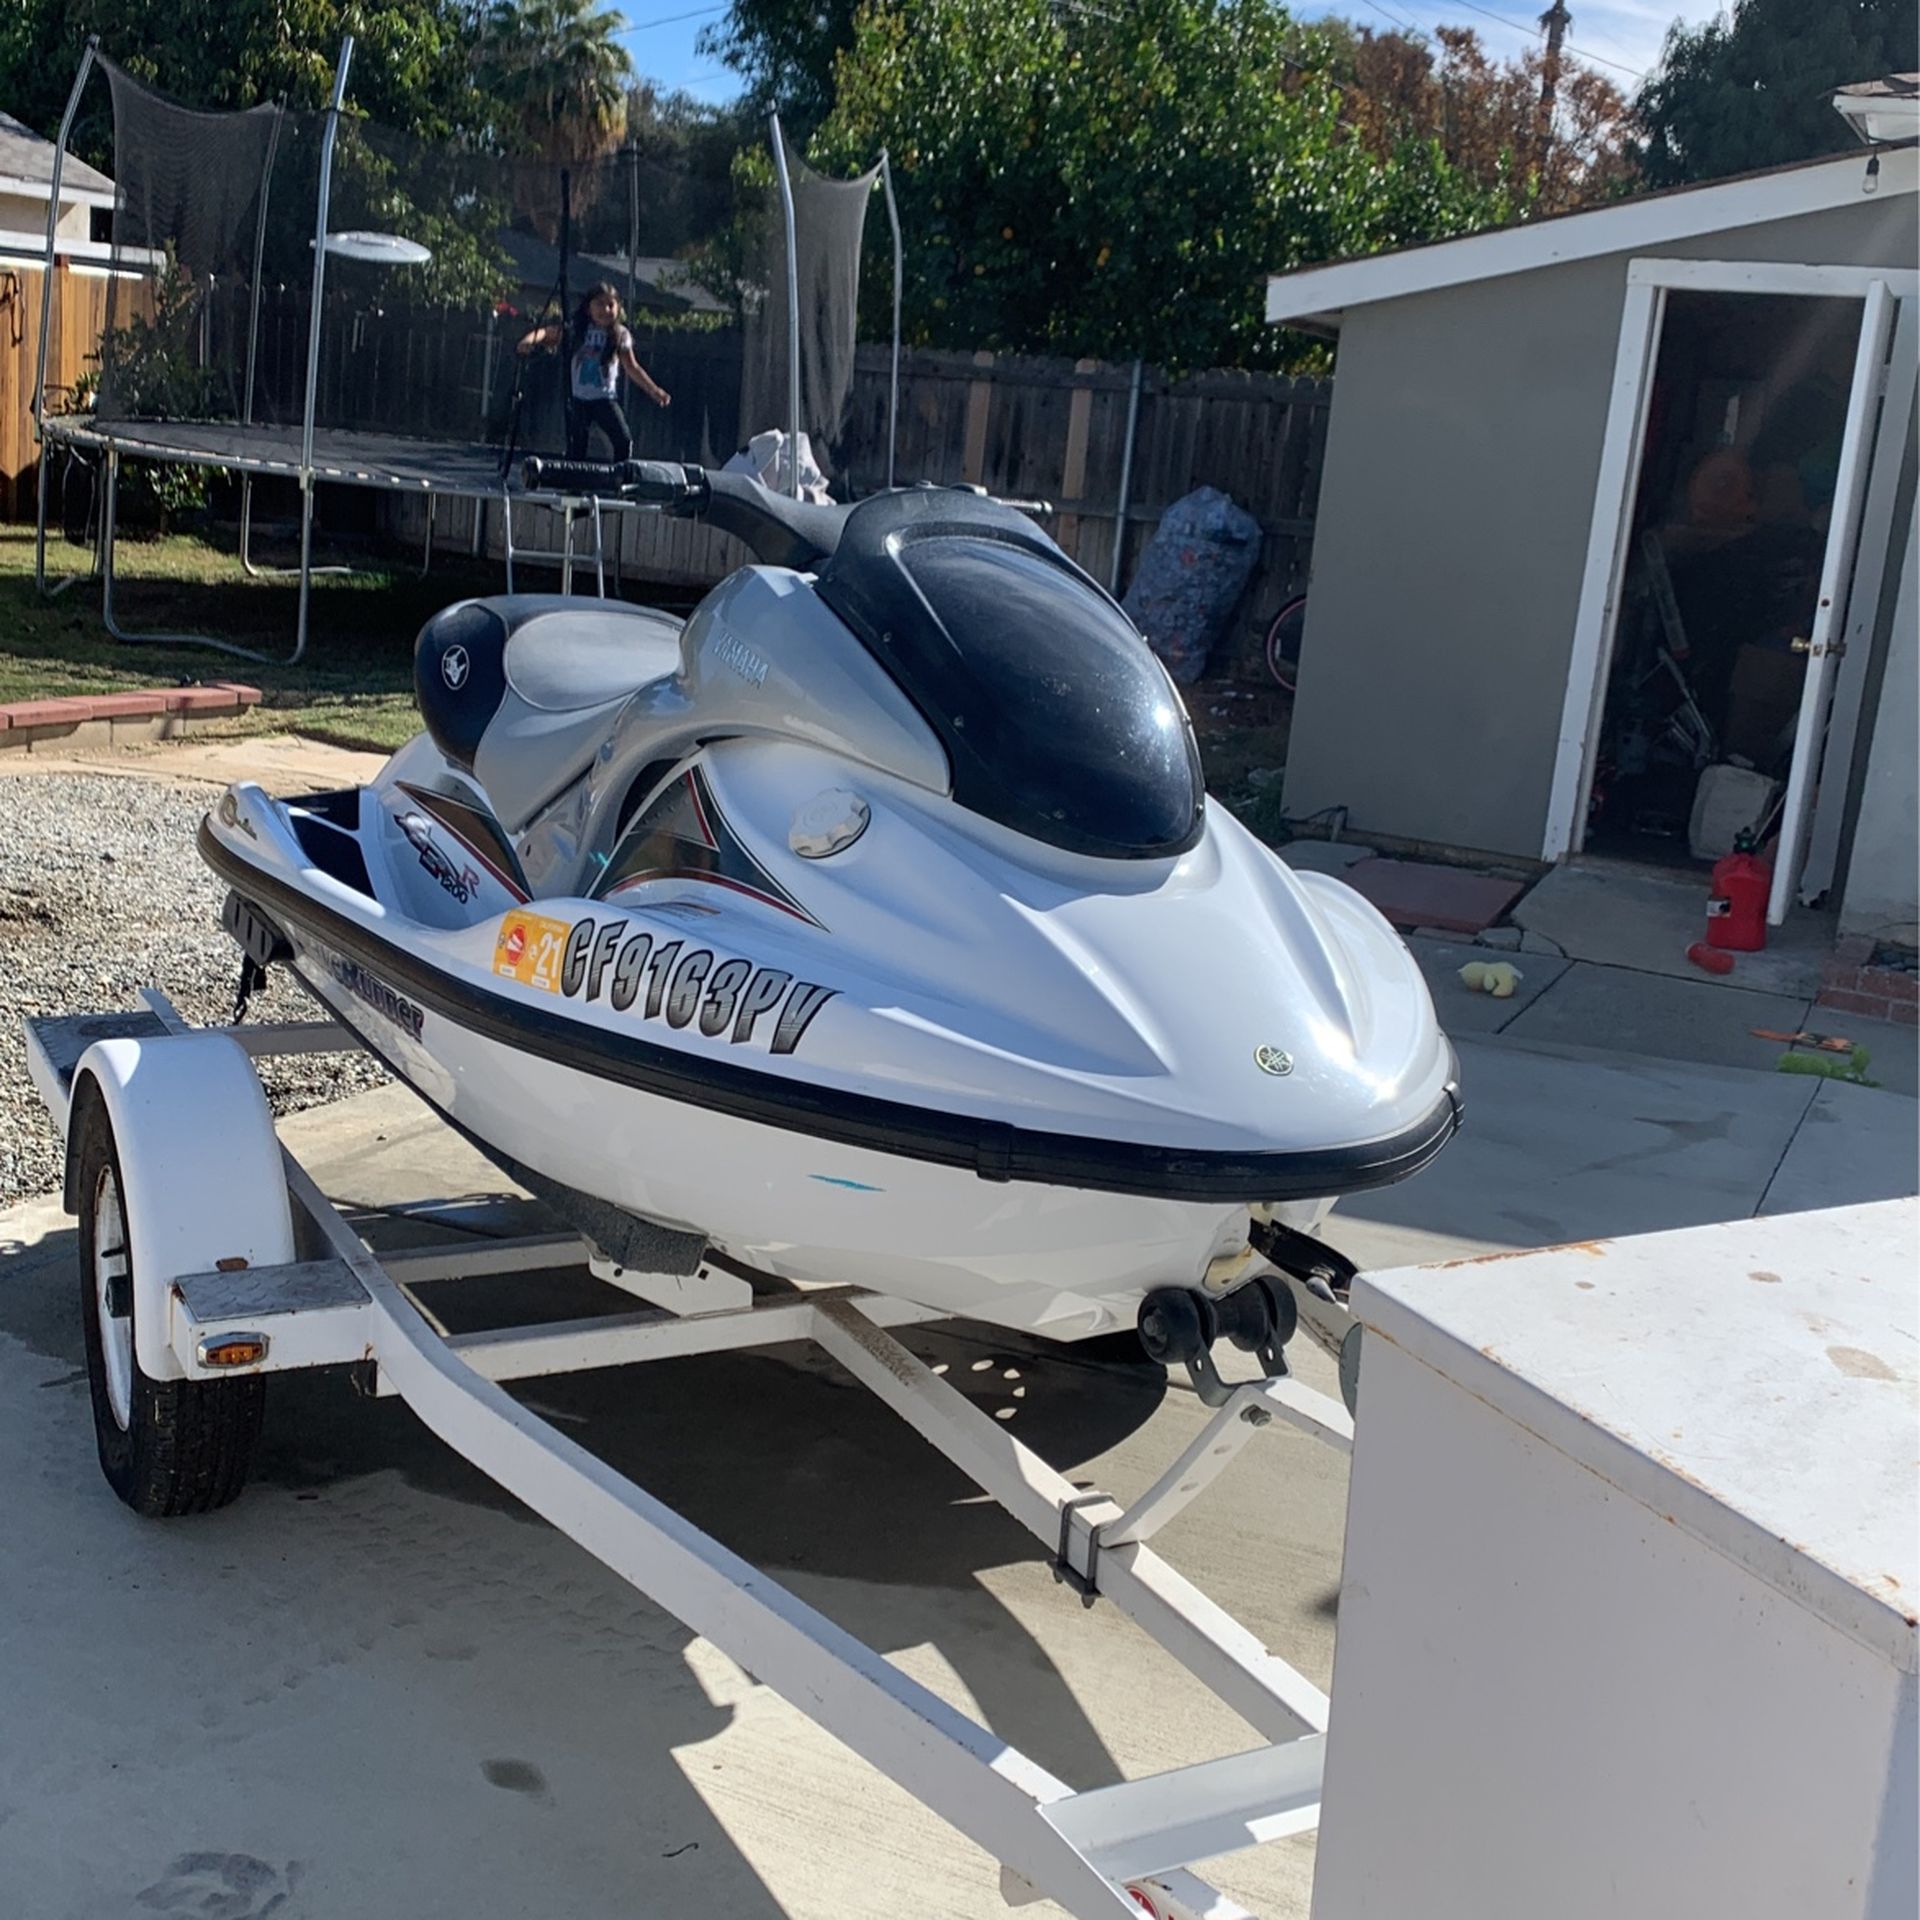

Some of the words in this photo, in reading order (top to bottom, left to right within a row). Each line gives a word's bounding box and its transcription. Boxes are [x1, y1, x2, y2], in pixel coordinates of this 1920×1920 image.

[712, 629, 769, 689] YAMAHA
[535, 931, 563, 979] 21
[560, 917, 845, 1055] CF9163PV
